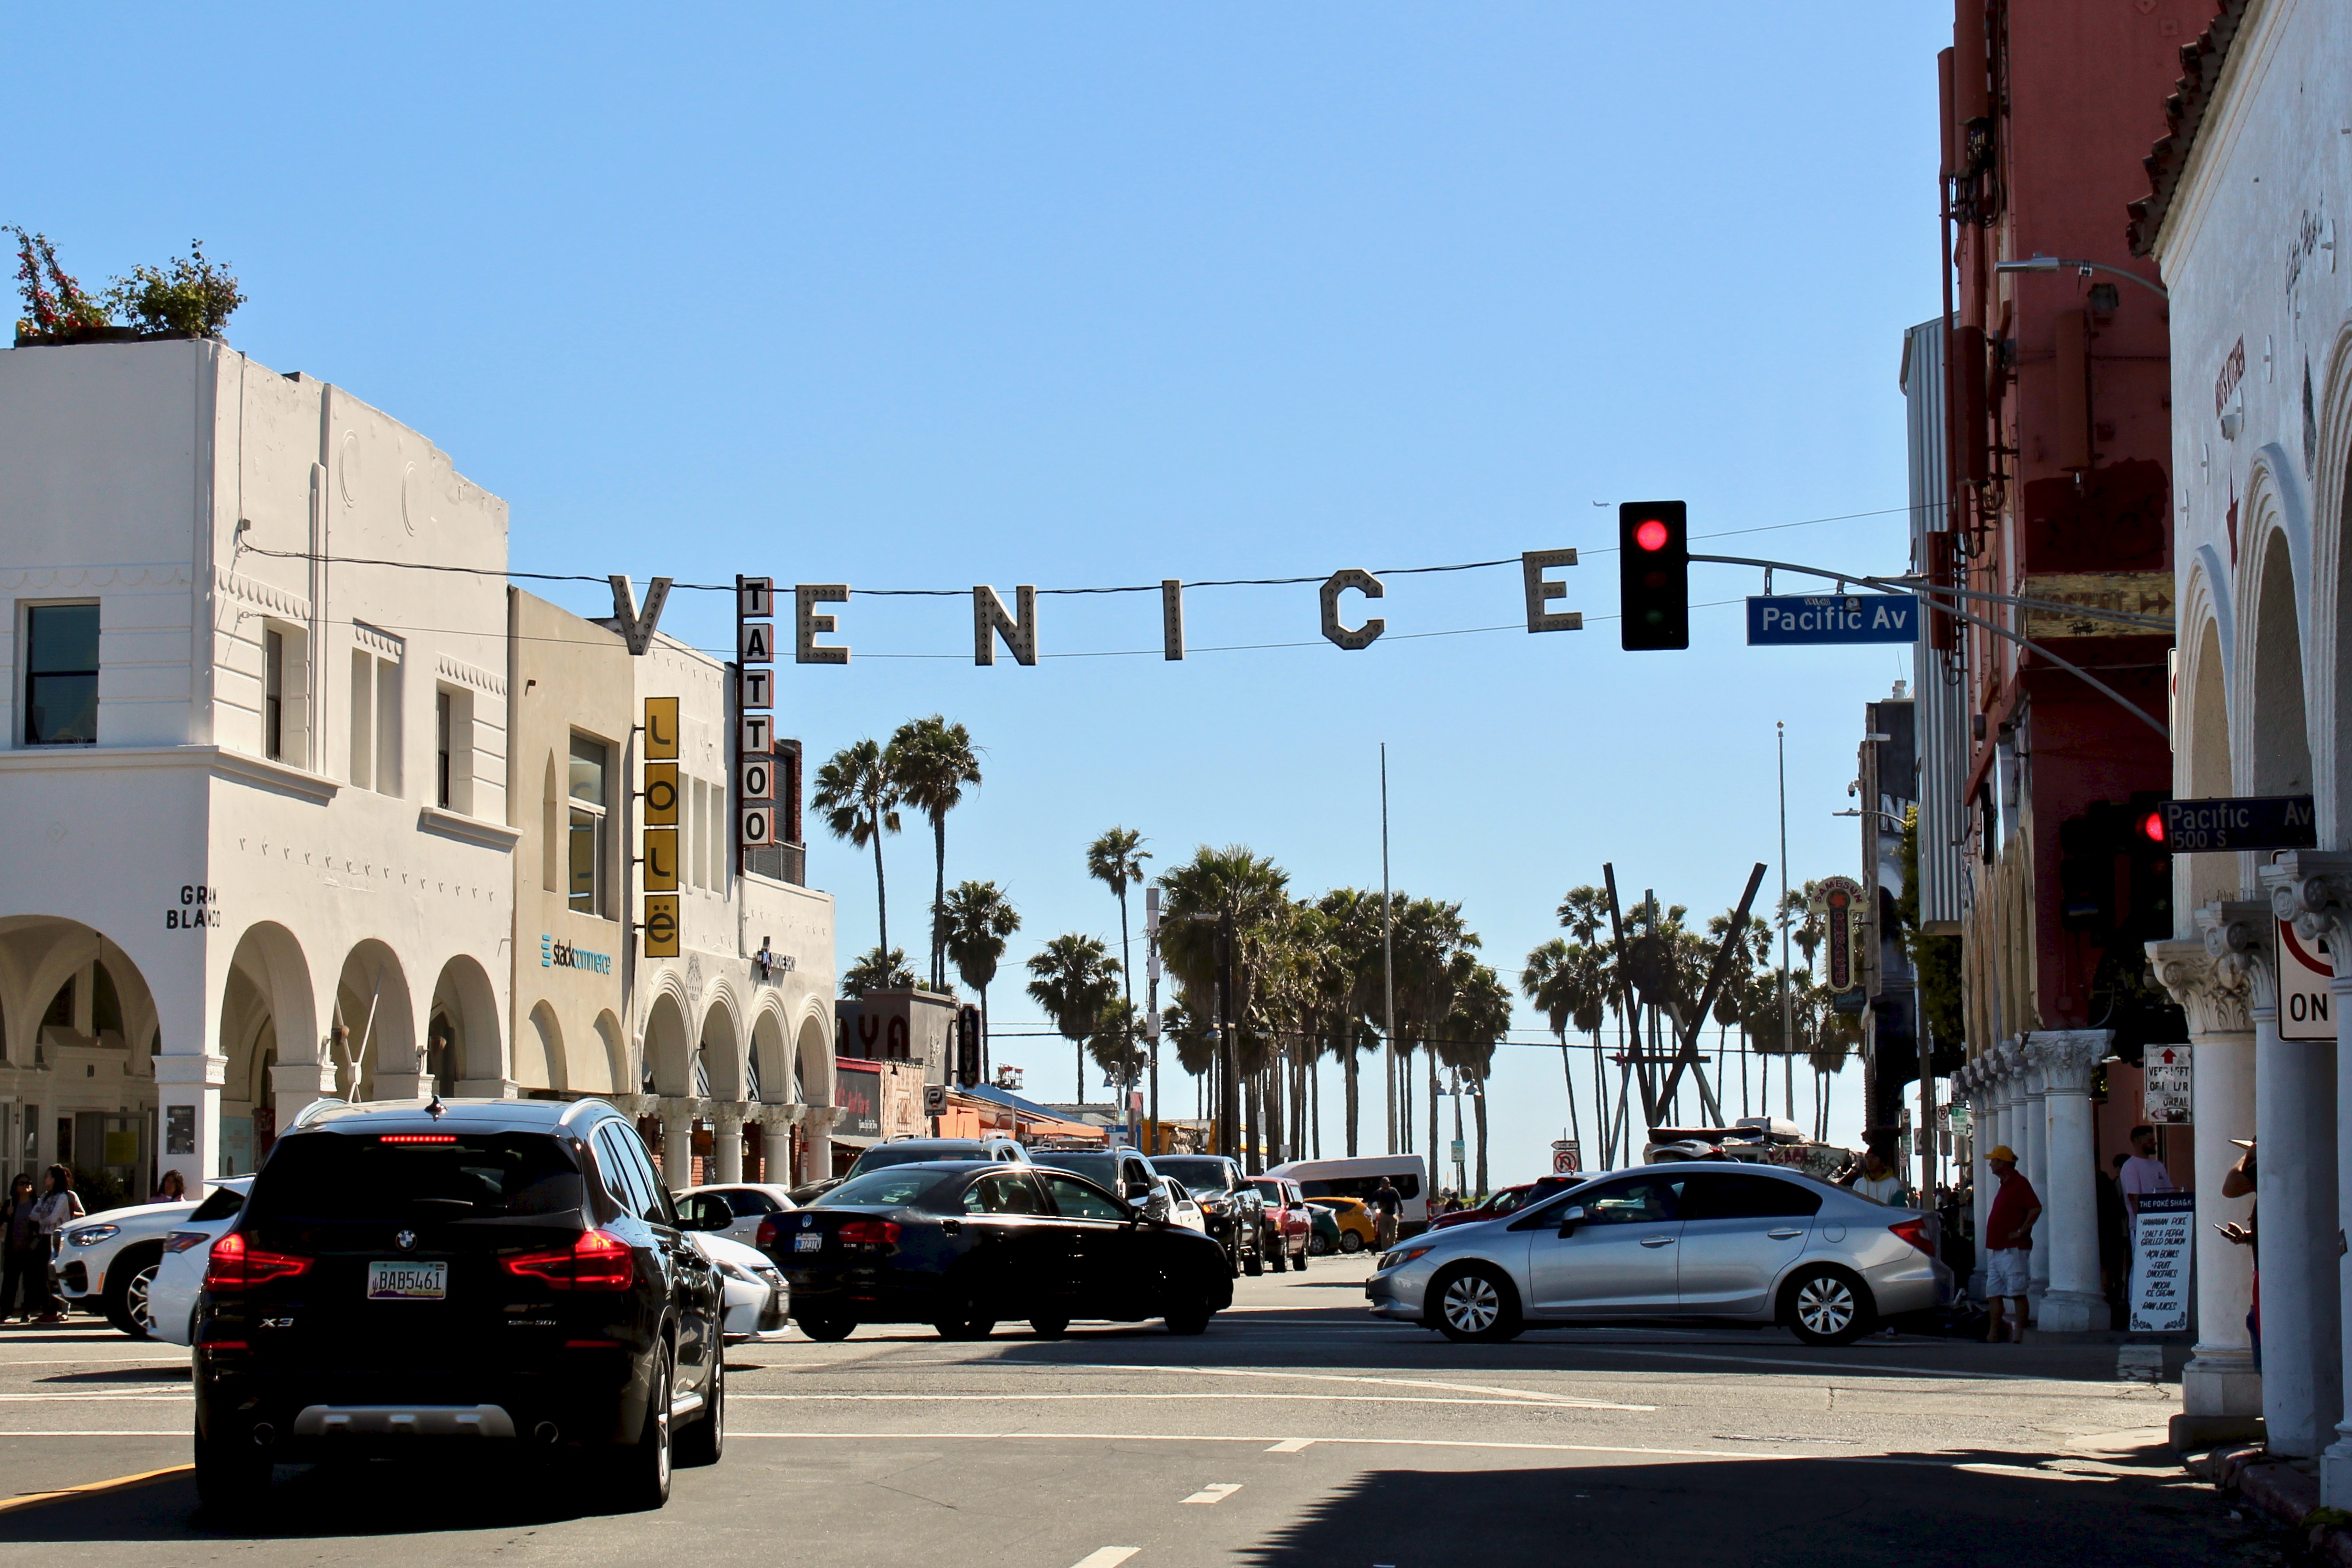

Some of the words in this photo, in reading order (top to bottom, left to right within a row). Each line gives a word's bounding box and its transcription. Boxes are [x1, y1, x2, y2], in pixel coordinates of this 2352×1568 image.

[608, 548, 1583, 666] VENICE
[1763, 605, 1862, 631] Pacific
[1872, 605, 1907, 629] Av
[745, 583, 766, 840] TATTOO
[2167, 802, 2250, 830] Pacific
[2284, 800, 2312, 827] Av
[2169, 830, 2208, 849] 1500
[2216, 829, 2227, 848] S
[181, 885, 217, 906] GRAN
[1814, 880, 1863, 903] SAMESUN
[166, 909, 221, 929] BLANCO
[553, 938, 611, 975] stackcommerce
[1834, 912, 1846, 986] BACKPACKERS
[771, 952, 786, 970] SMOKE
[2290, 992, 2328, 1022] ON
[2141, 1237, 2164, 1246] GRILLED
[2159, 1249, 2179, 1258] BOWLS
[2146, 1269, 2178, 1278] SMOOTHIES
[2154, 1261, 2171, 1269] FRUIT
[379, 1271, 442, 1290] BAB5461
[2156, 1301, 2177, 1311] JUICES
[259, 1318, 294, 1327] X3
